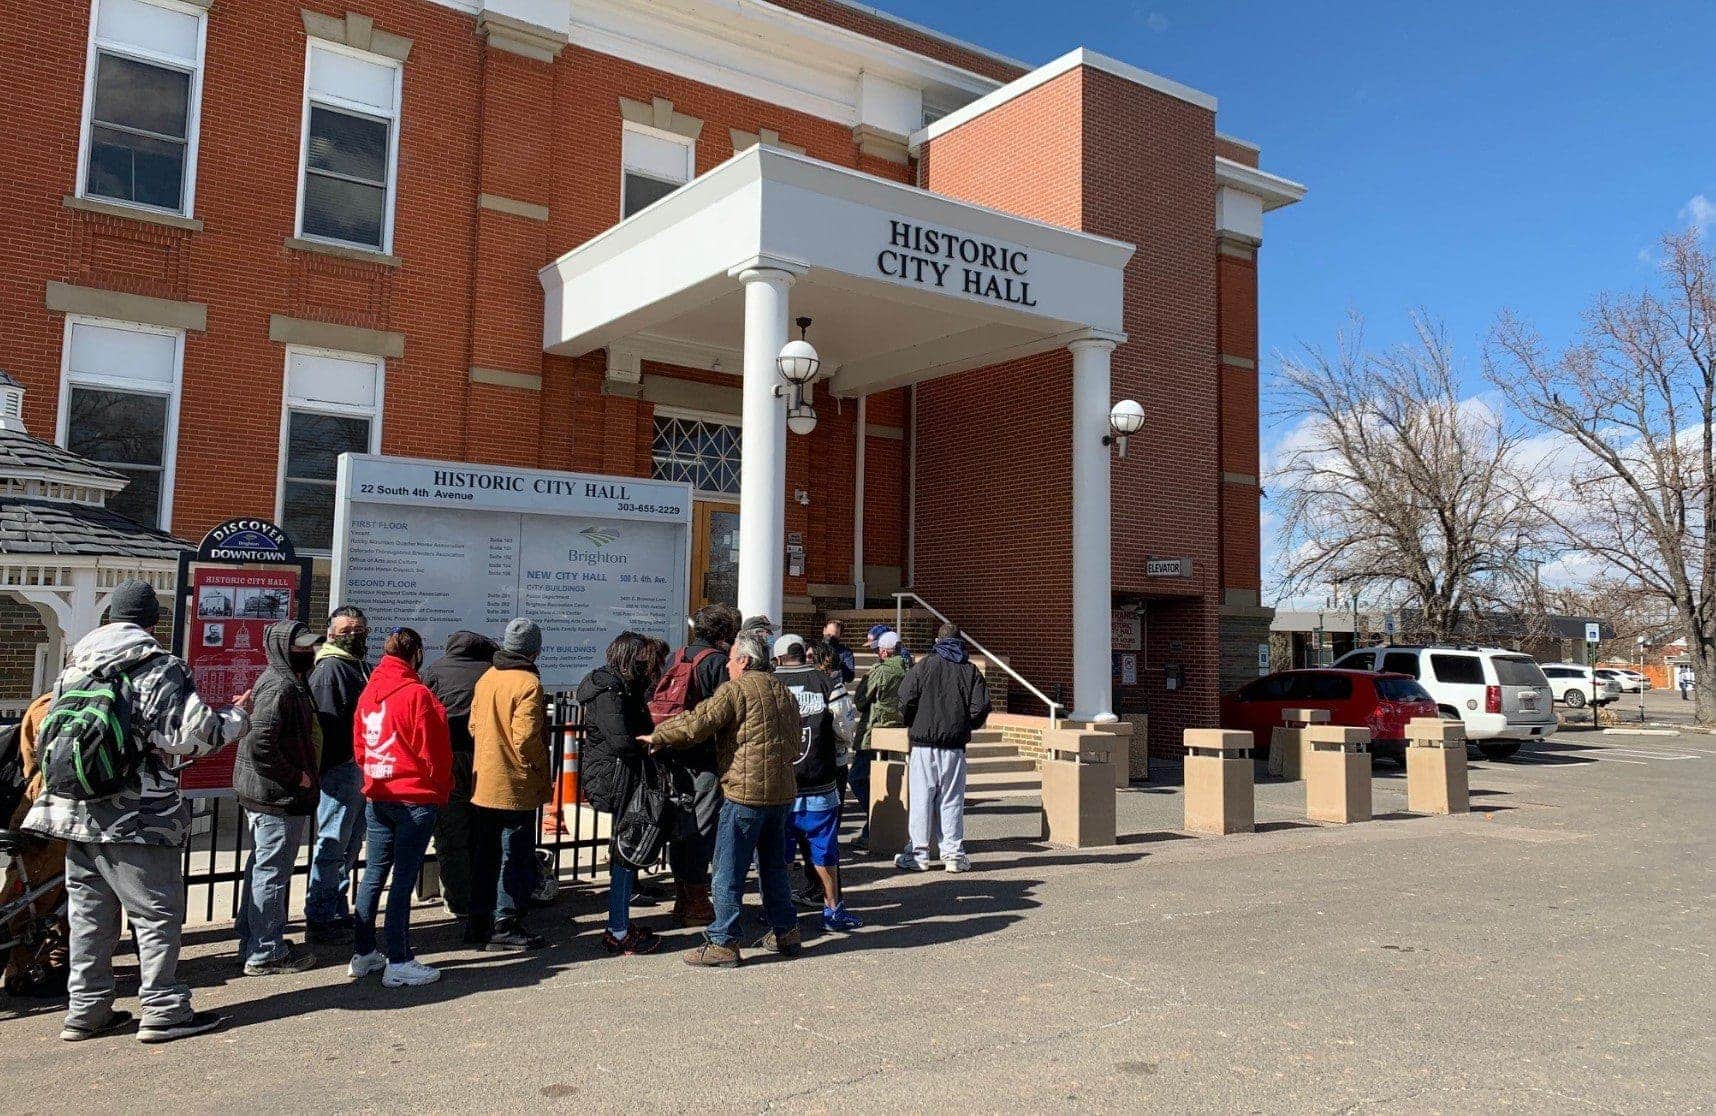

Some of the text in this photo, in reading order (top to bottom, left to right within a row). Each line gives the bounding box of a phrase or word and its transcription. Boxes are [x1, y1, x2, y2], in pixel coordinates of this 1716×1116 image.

[889, 219, 1028, 275] HISTORIC
[877, 250, 1037, 307] CITY HALL
[434, 470, 631, 500] HISTORIC CITY HALL
[361, 484, 474, 501] 22 South 4th Avenue
[617, 503, 680, 515] 303-655-2229
[351, 520, 408, 530] FIRST FLOOR
[213, 520, 285, 544] DISCOVER
[211, 549, 286, 561] DOWNTOWN
[568, 549, 628, 567] Brighton
[1148, 563, 1180, 573] ELEVATOR
[205, 576, 289, 586] HISTORIC CITY HALL
[526, 570, 608, 582] NEW CITY HALL
[347, 579, 417, 588] SECOND FLOOR
[545, 584, 586, 593] BUILDINGS
